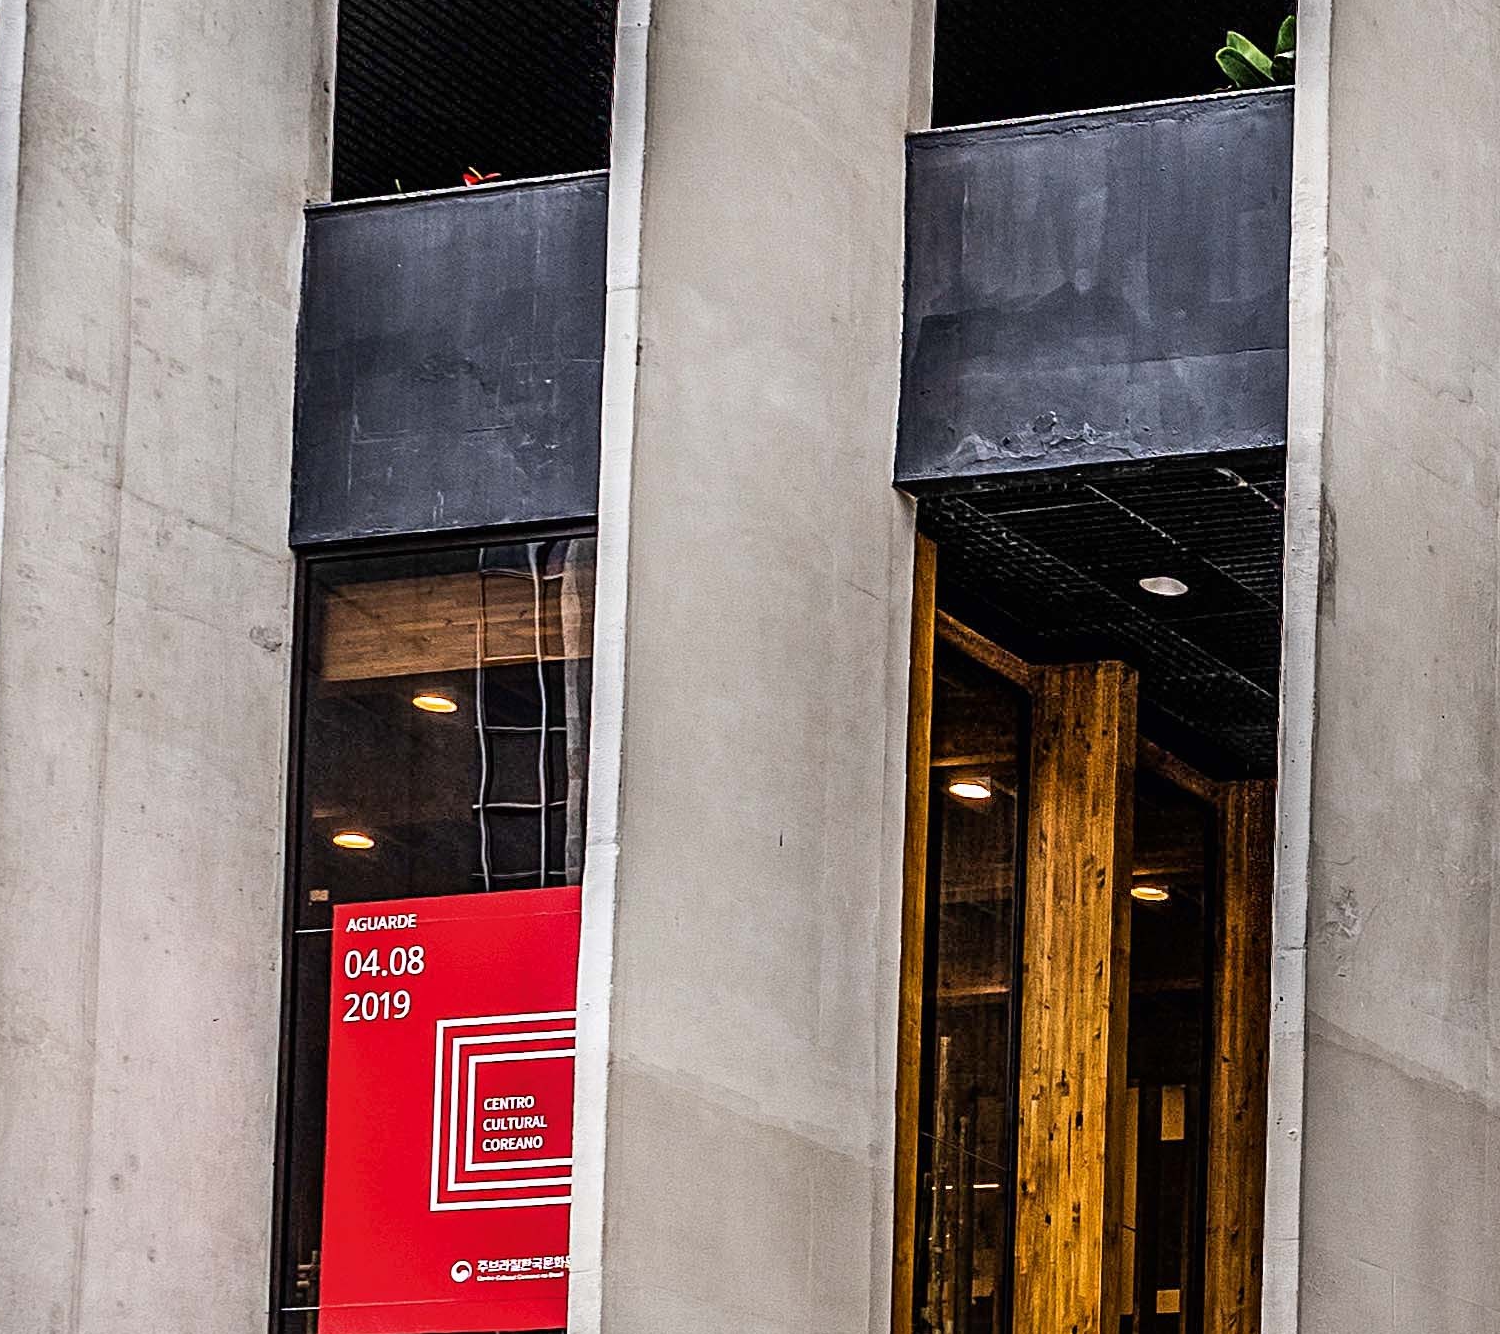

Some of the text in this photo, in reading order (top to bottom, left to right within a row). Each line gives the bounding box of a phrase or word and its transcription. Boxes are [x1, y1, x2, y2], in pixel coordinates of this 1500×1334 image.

[345, 913, 418, 933] AGUARDE
[344, 945, 425, 979] 04.08
[342, 989, 411, 1022] 2019
[483, 1095, 535, 1111] CENTRO
[482, 1115, 548, 1132] CULTURAL
[482, 1135, 543, 1152] COREANO
